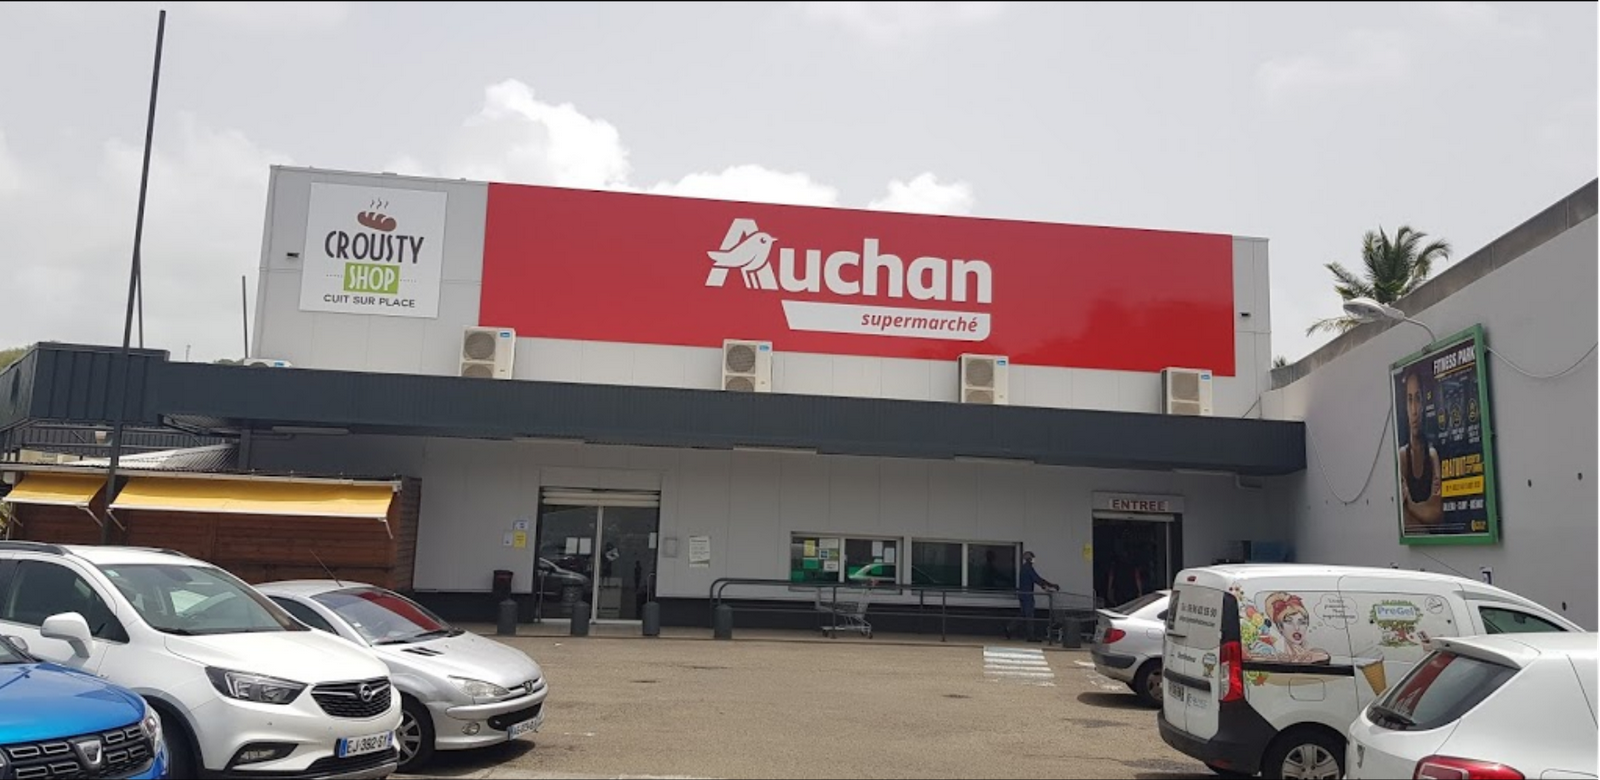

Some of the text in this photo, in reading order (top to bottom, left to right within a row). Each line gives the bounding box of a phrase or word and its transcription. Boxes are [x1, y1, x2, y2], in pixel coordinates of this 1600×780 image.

[324, 230, 425, 264] CROUSTY
[705, 218, 992, 303] Auchan
[348, 265, 395, 291] SHOP
[323, 294, 416, 308] CUIT SUR PLACE
[861, 312, 978, 332] supermarché
[1433, 352, 1457, 375] FITNESS
[1112, 499, 1166, 512] ENTREE
[1377, 606, 1415, 616] PreGel
